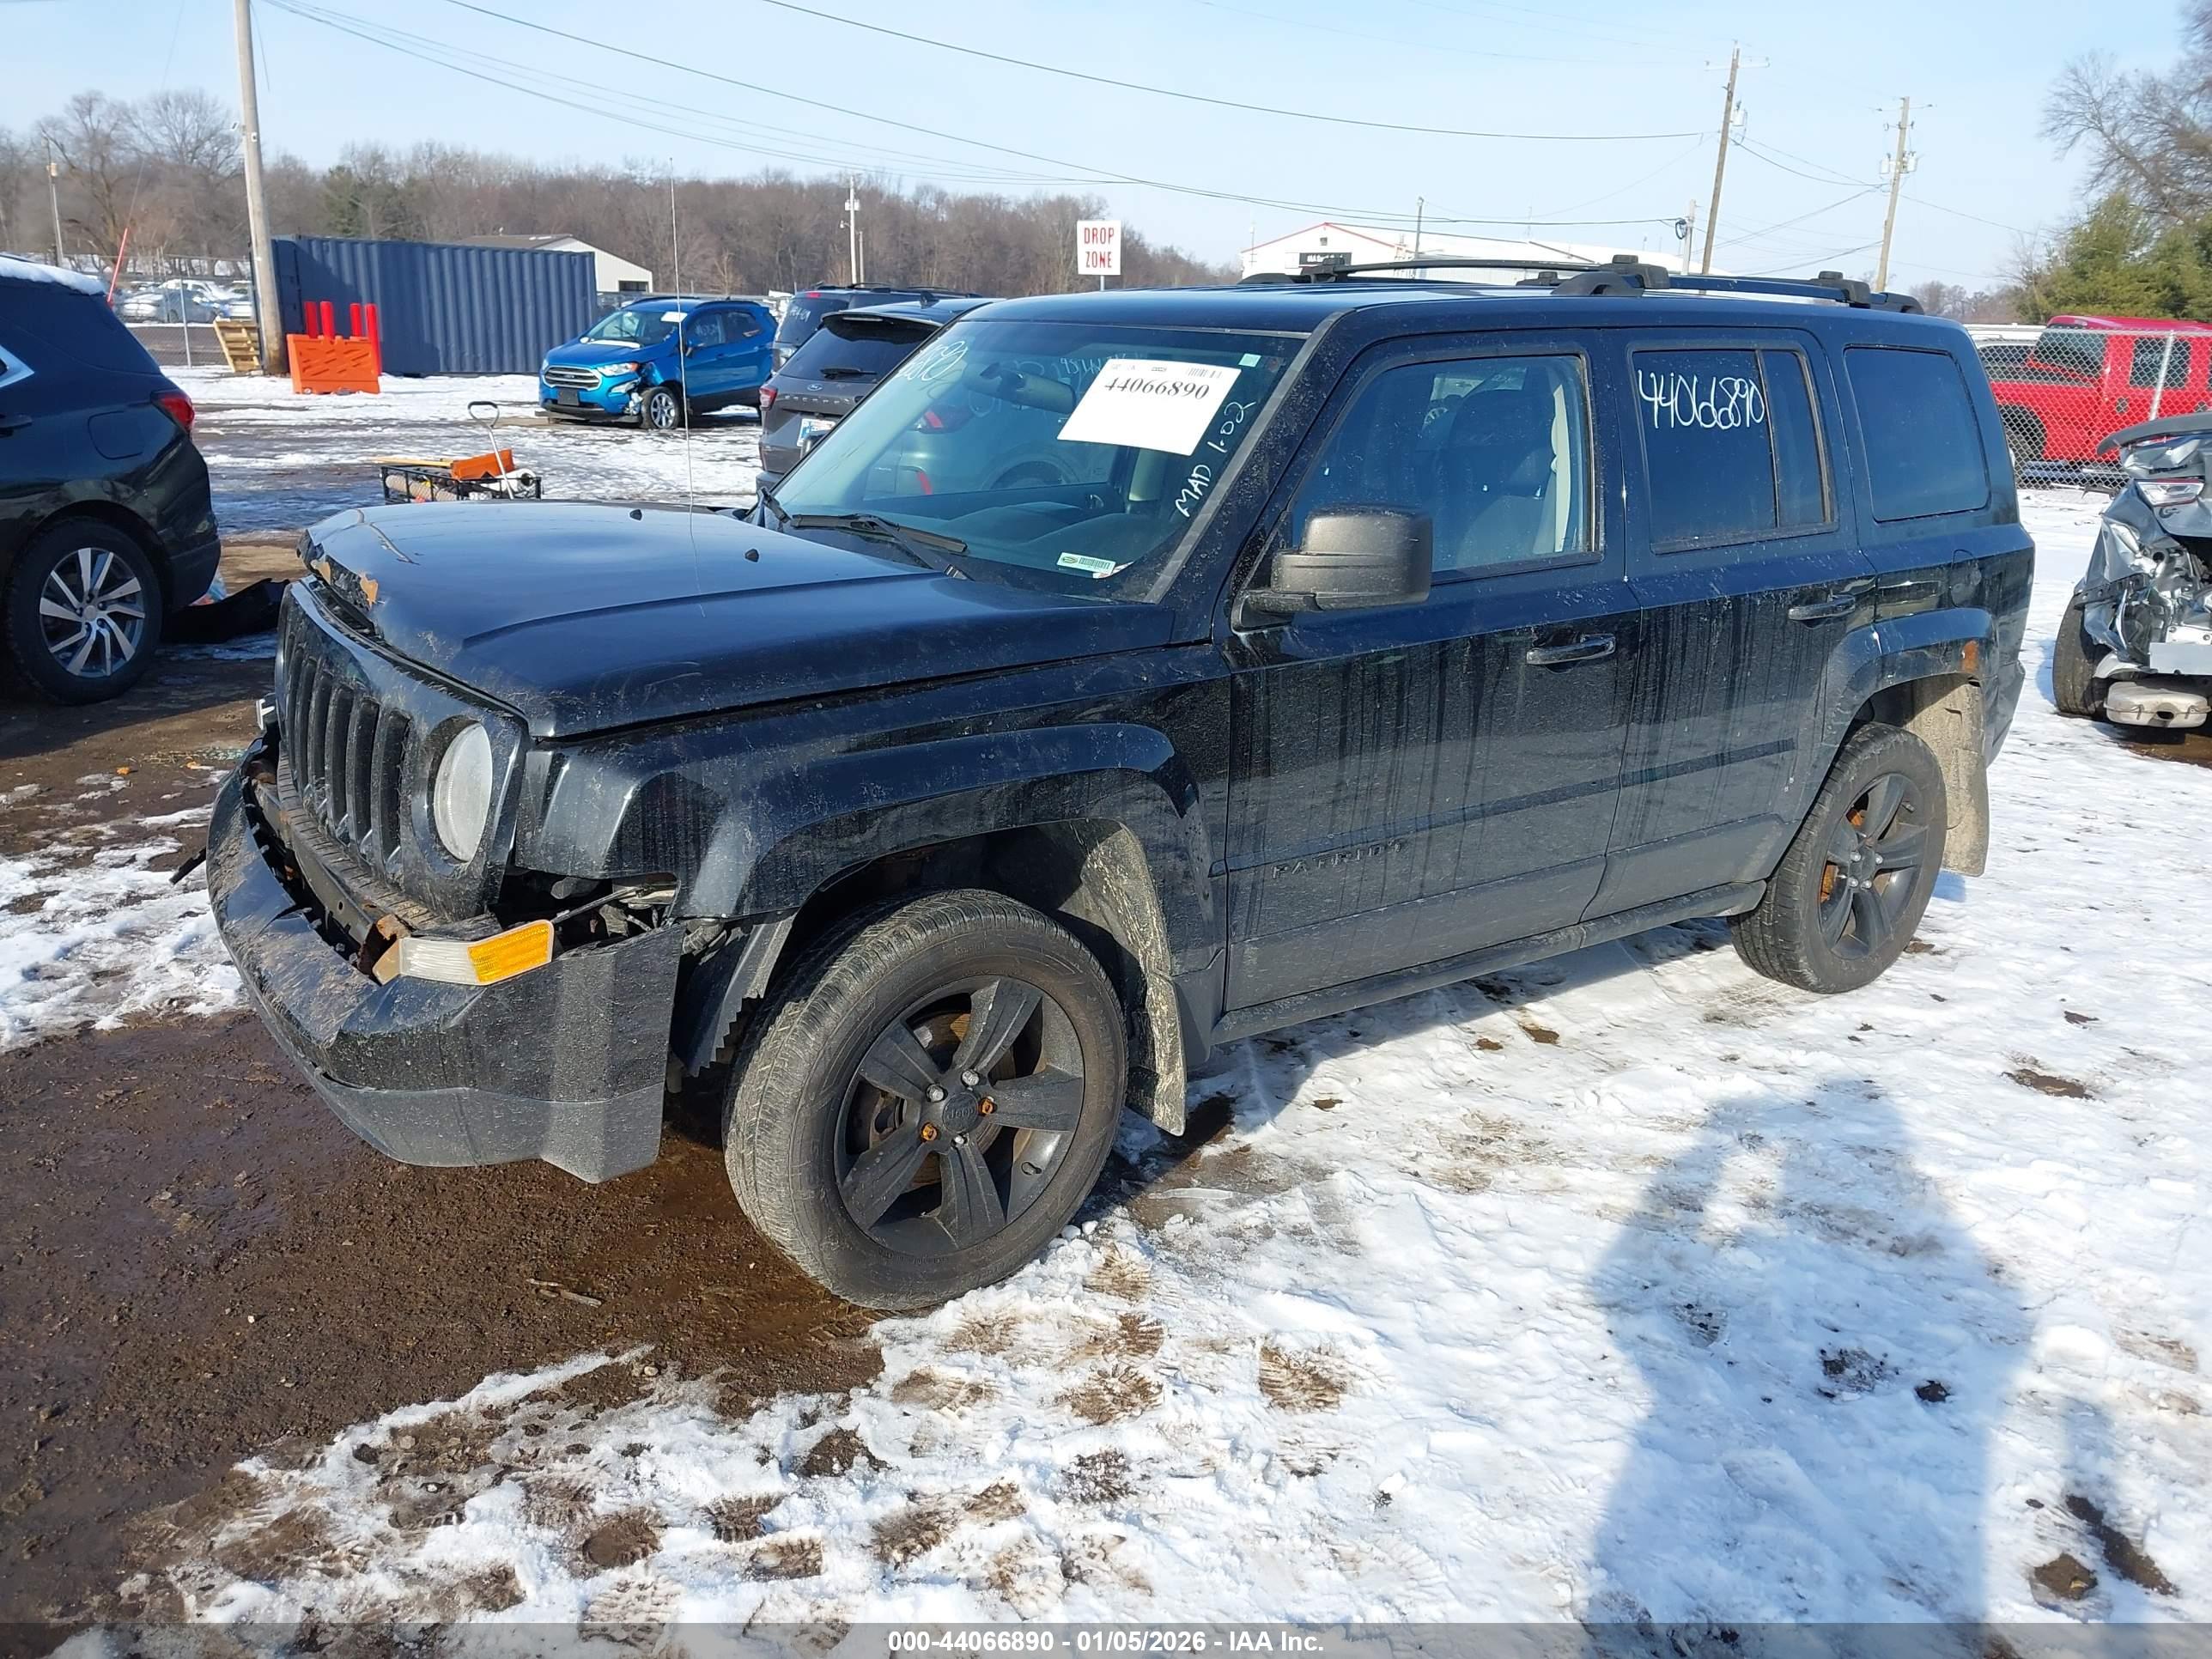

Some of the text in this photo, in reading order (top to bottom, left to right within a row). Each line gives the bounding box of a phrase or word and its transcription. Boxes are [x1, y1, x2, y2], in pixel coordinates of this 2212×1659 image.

[1084, 227, 1115, 245] DROP
[1085, 251, 1112, 269] ZONE
[1104, 377, 1210, 400] 44066890
[1637, 368, 1765, 430] 44066890
[1175, 464, 1212, 518] MAD
